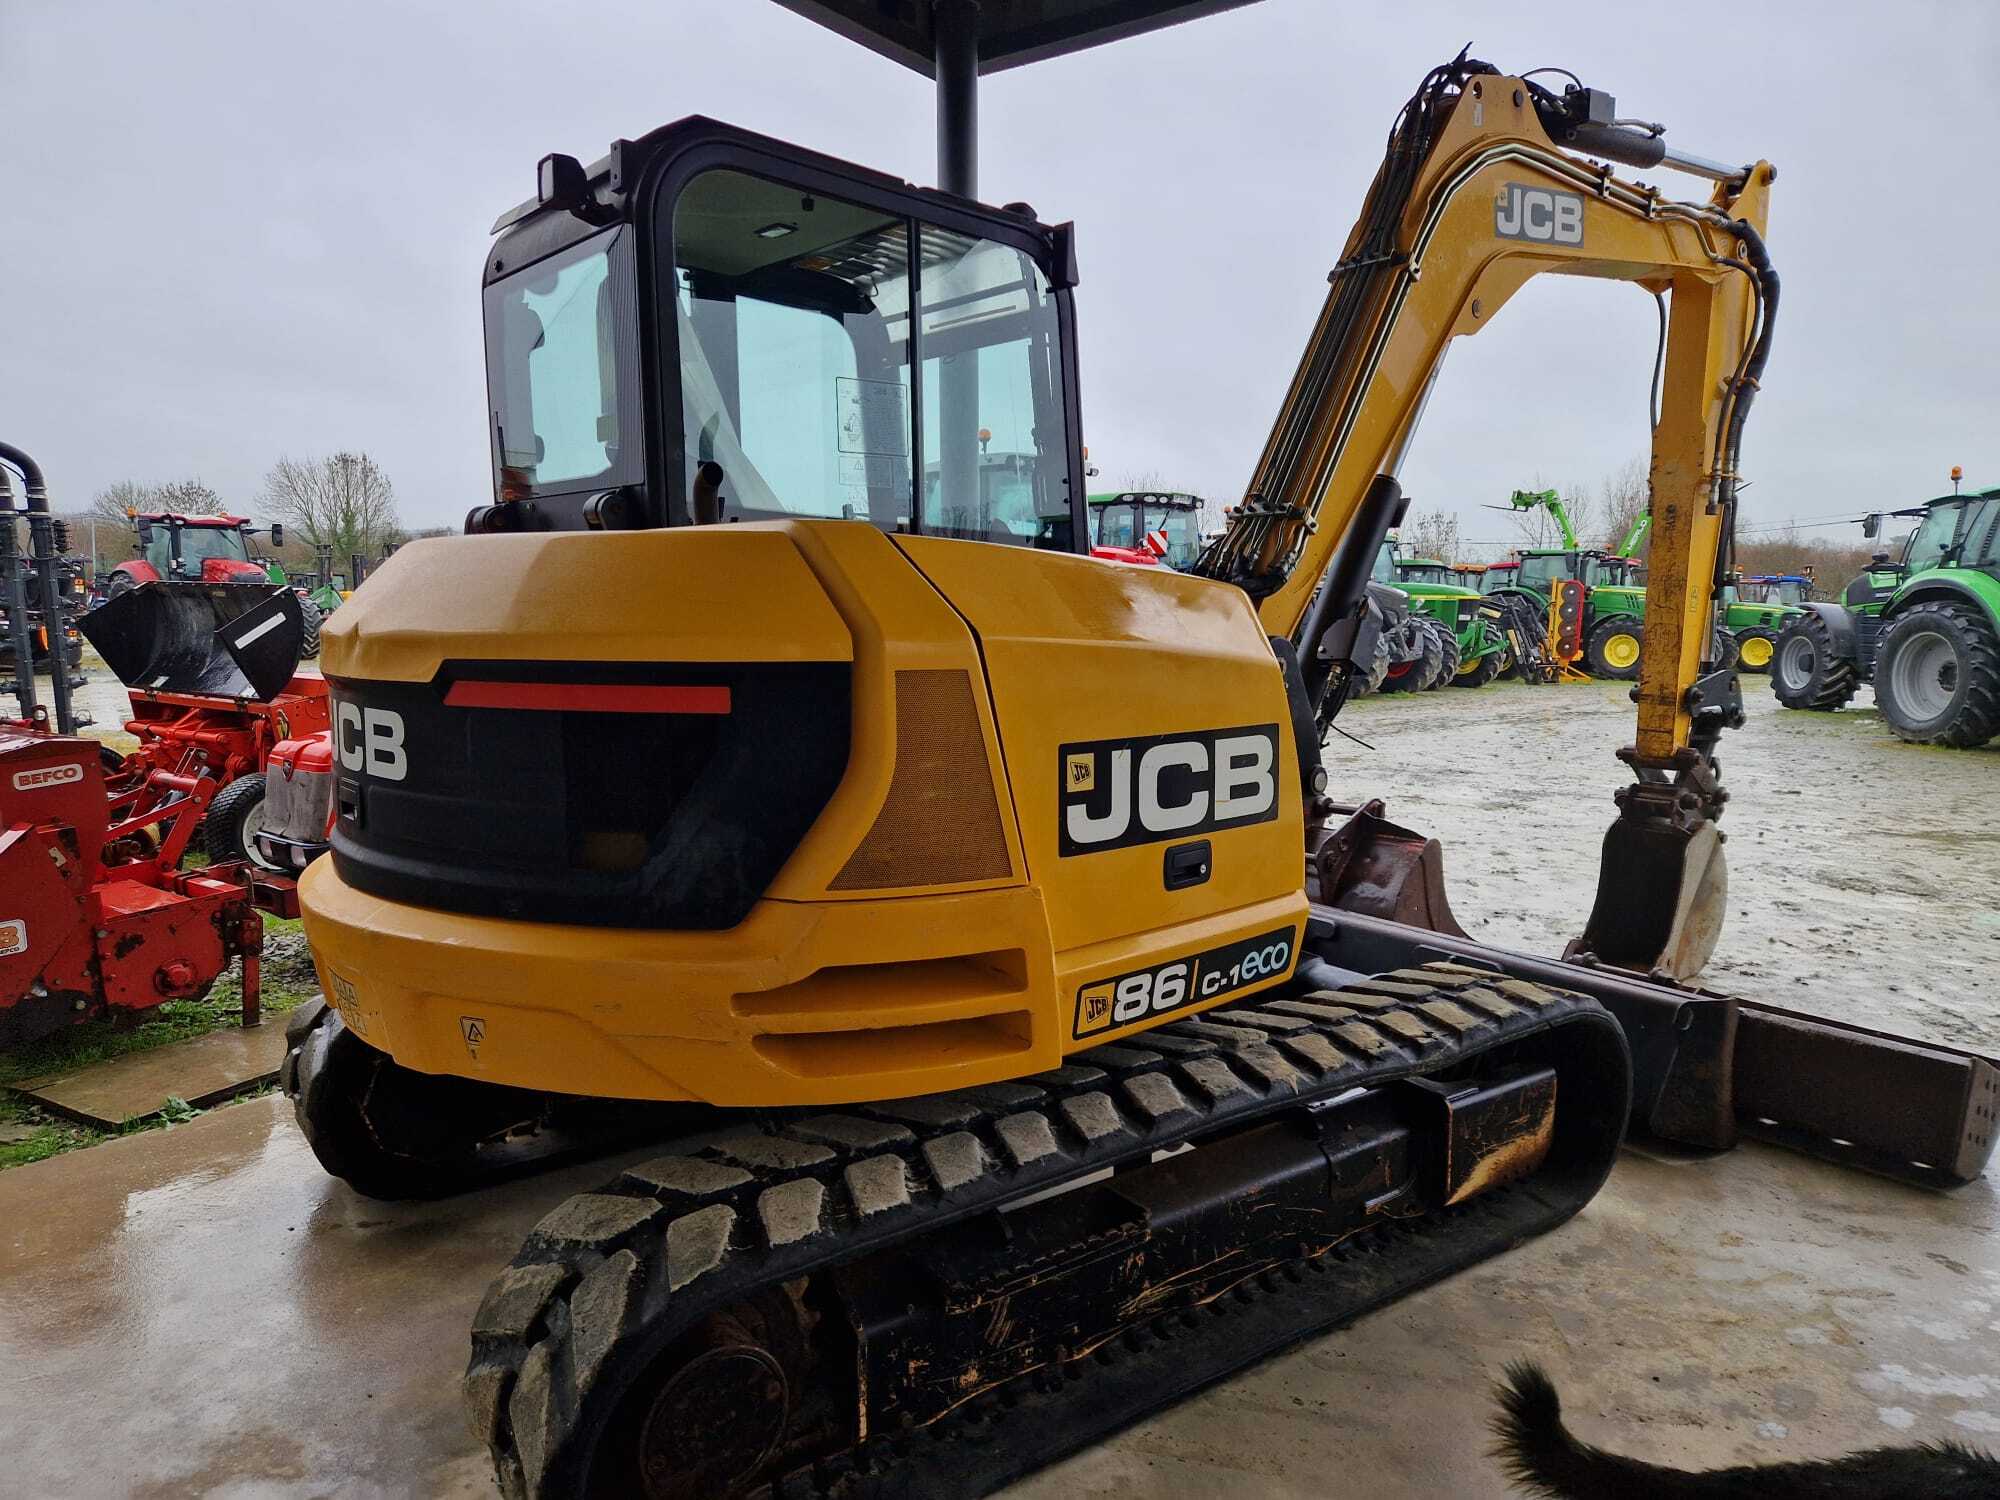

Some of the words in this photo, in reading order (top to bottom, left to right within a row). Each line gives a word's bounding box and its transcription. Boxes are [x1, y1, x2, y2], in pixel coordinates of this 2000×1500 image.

[1496, 188, 1582, 243] JCB
[18, 767, 77, 787] BEFCO
[1067, 734, 1275, 844] JCB
[1073, 763, 1091, 782] JCB
[1113, 963, 1188, 1023] 86
